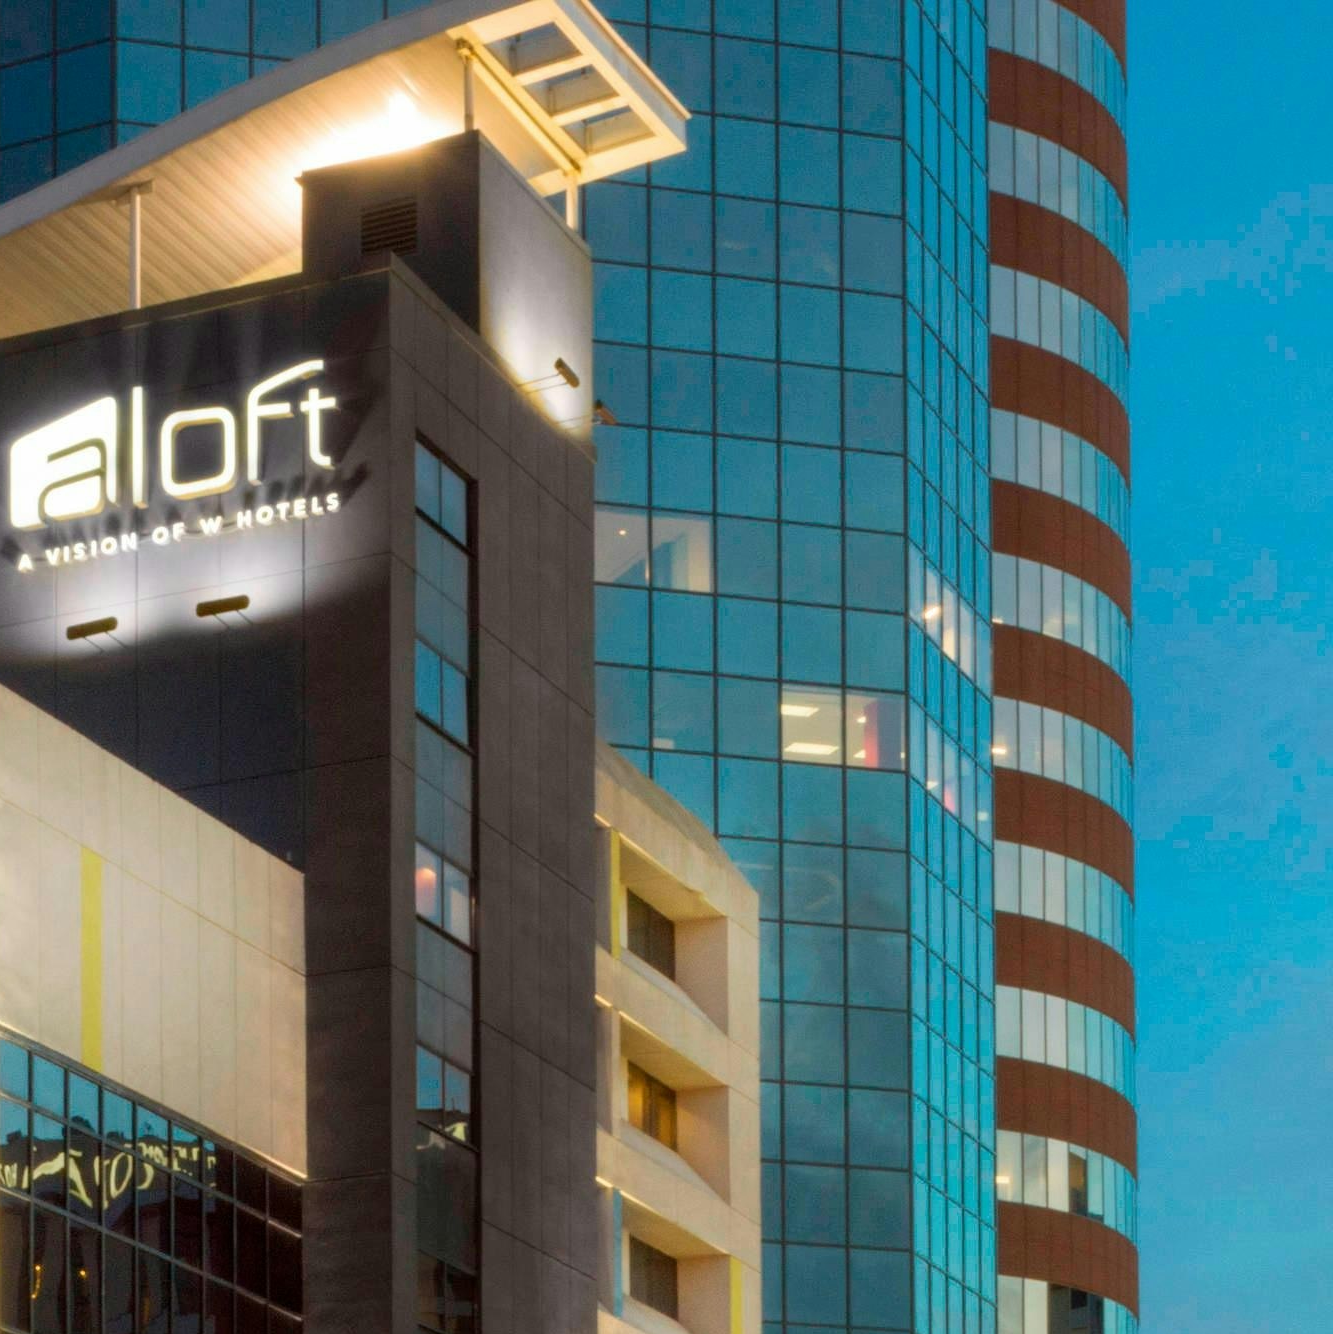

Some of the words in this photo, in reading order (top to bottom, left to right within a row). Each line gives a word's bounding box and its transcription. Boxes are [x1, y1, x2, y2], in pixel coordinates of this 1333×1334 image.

[9, 358, 338, 529] aloft
[17, 553, 33, 574] A
[46, 531, 138, 565] VISION
[152, 522, 185, 545] OF
[199, 515, 224, 536] W
[236, 493, 340, 529] HOTELS
